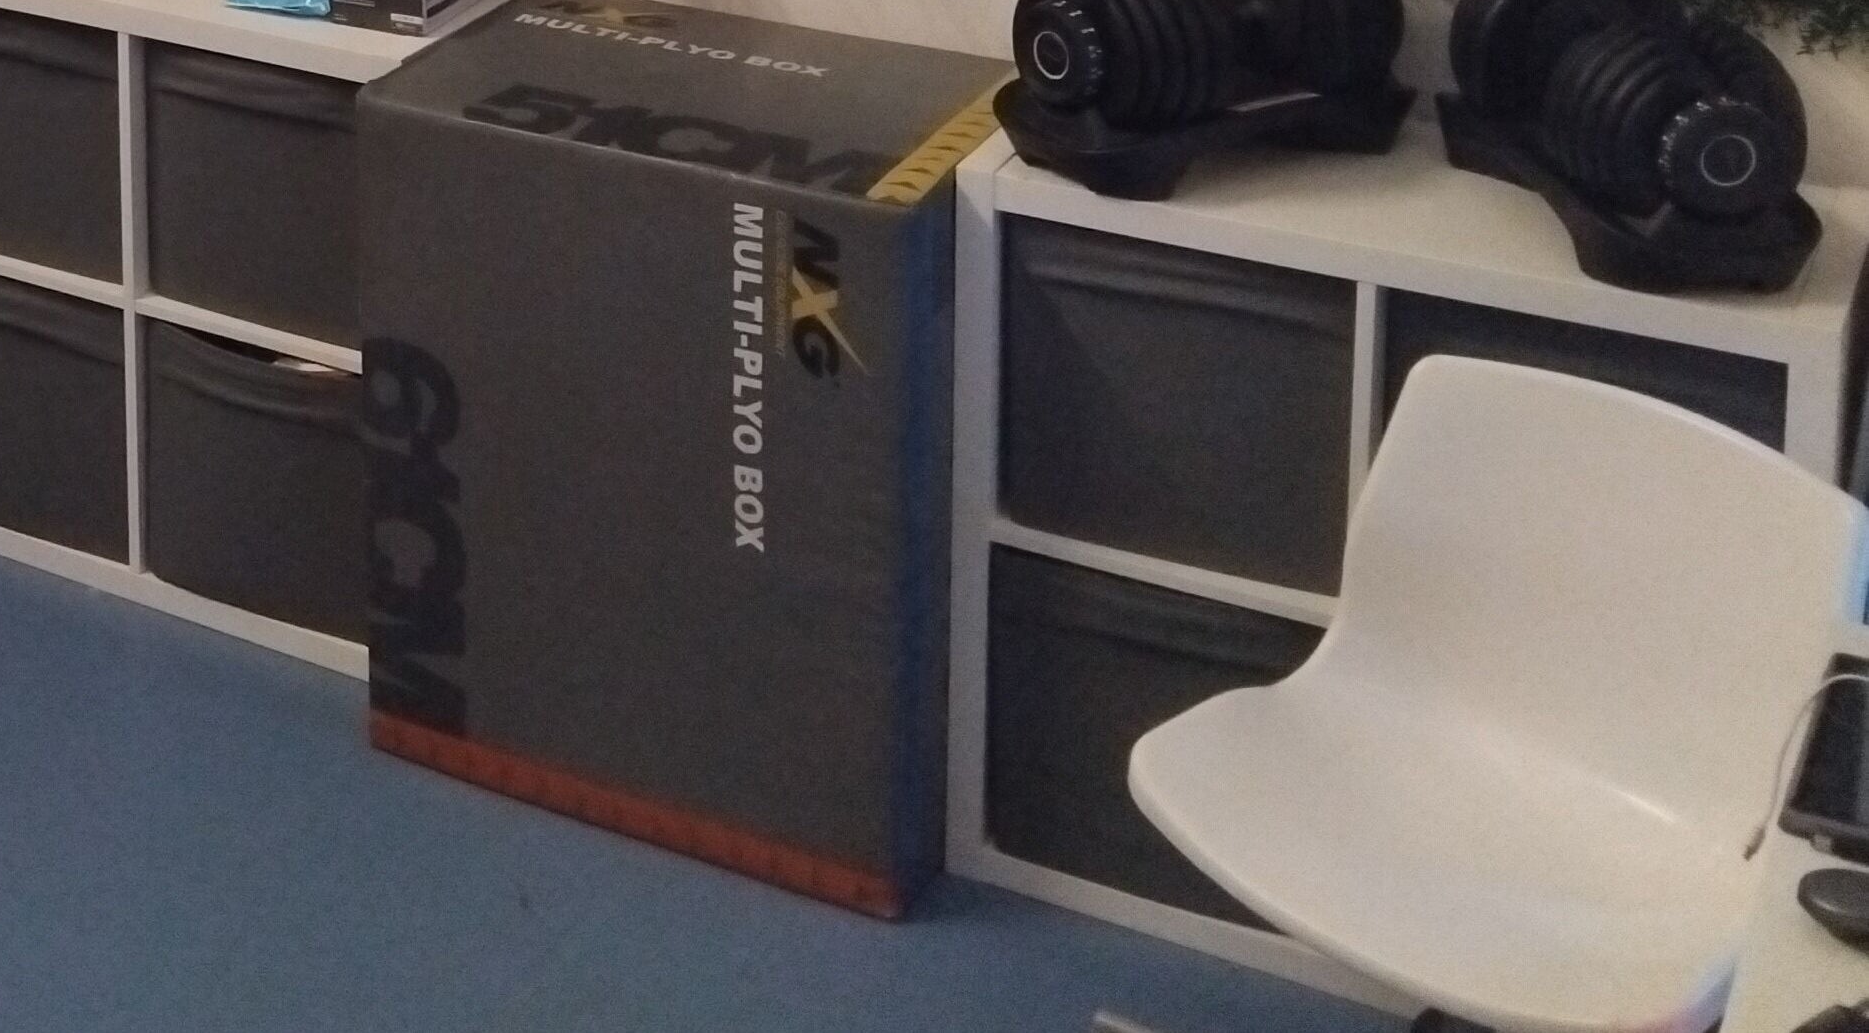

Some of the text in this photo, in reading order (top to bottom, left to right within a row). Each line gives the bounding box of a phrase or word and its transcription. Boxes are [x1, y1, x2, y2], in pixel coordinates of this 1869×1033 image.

[513, 12, 831, 78] MULTI-PLYO BOX
[462, 82, 906, 197] 51CM
[732, 202, 765, 553] MULTI-PLYO BOX
[791, 217, 869, 380] NXG
[363, 335, 469, 737] 61CM
